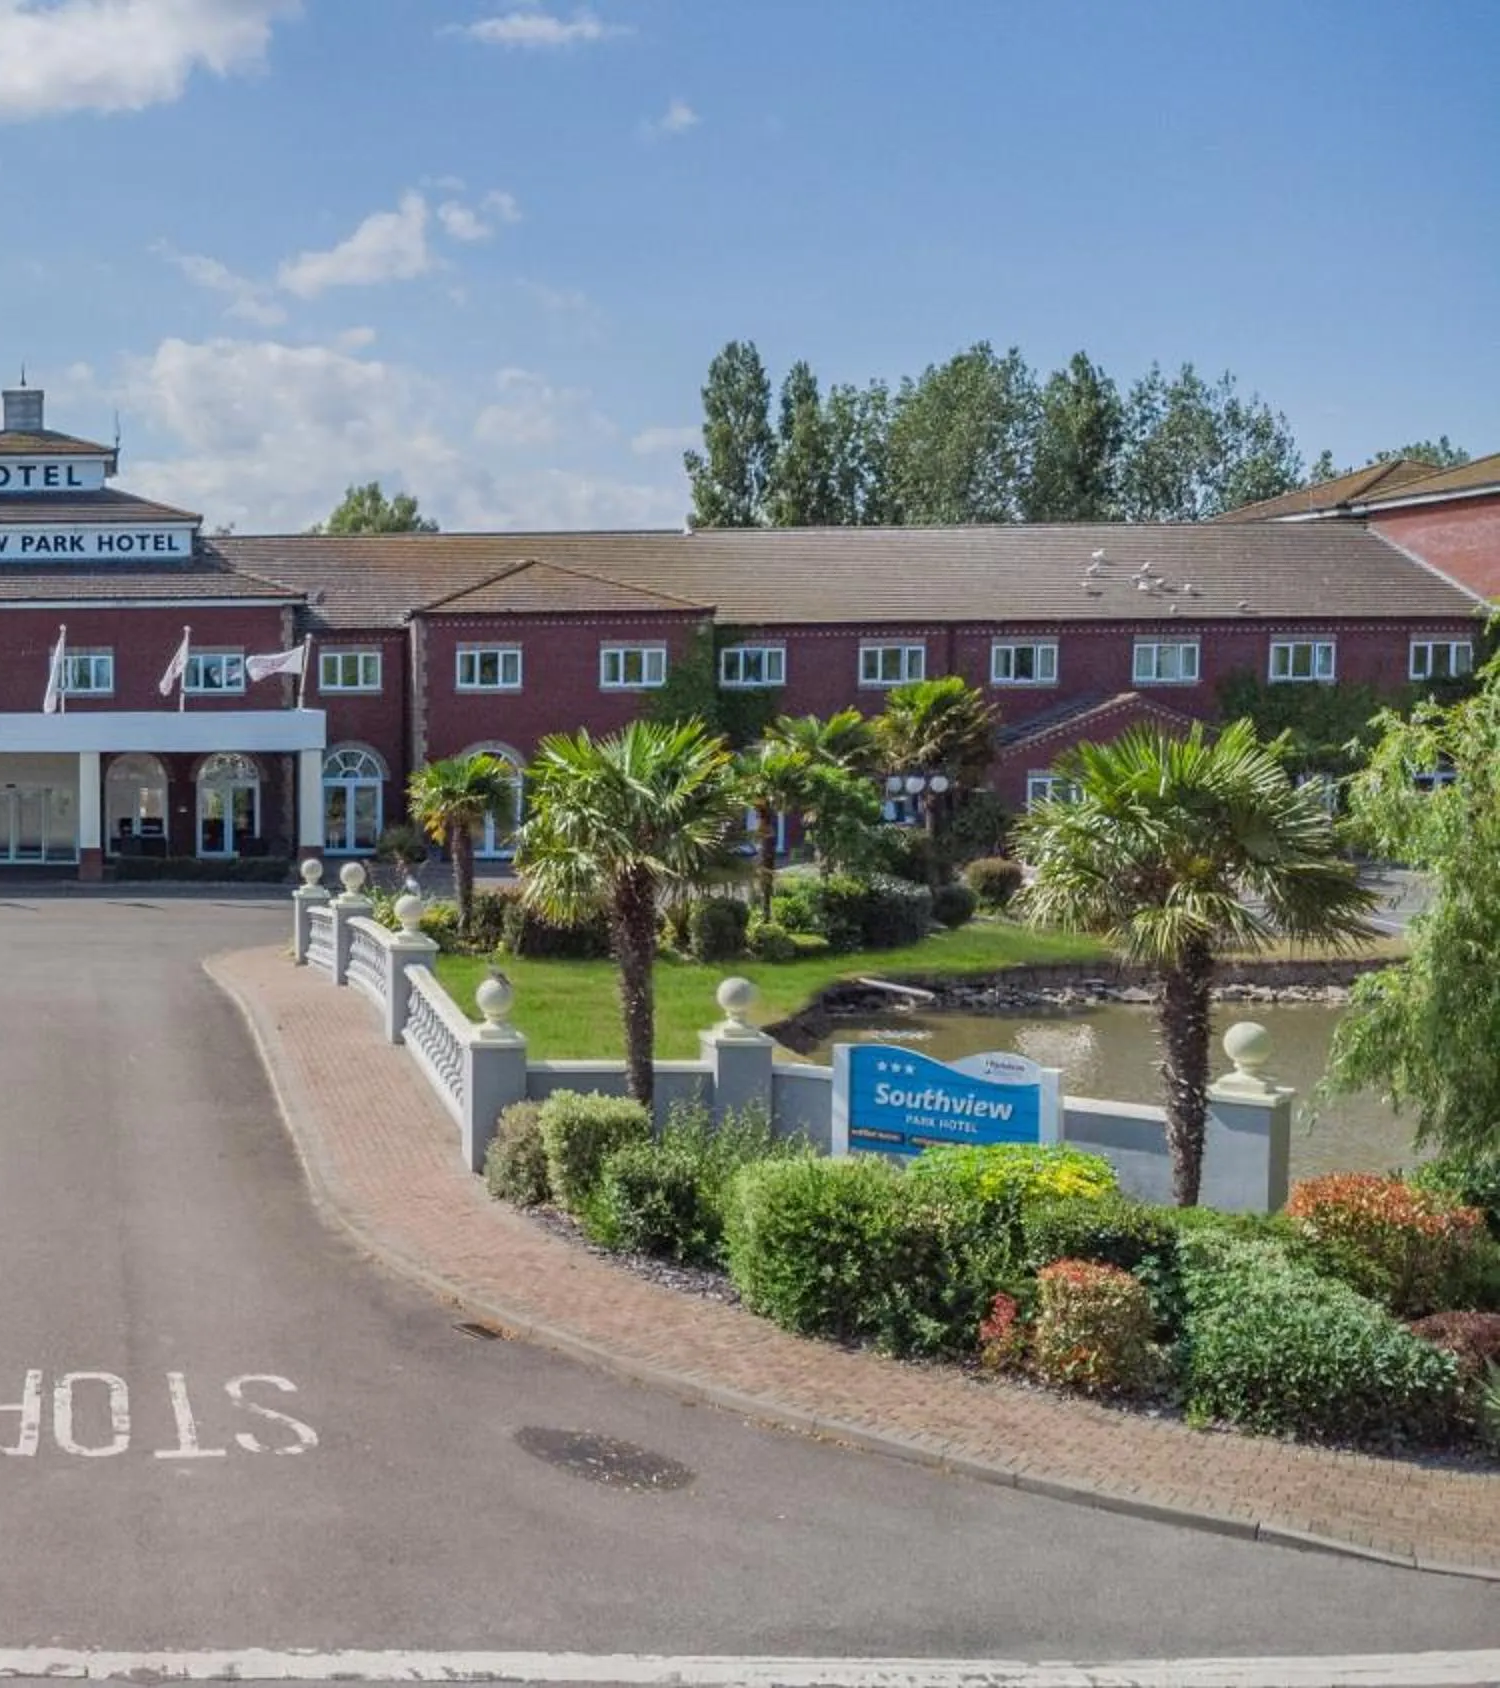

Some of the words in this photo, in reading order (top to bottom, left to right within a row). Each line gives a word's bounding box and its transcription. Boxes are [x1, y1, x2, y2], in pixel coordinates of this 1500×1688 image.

[21, 535, 85, 553] PARK
[97, 534, 180, 552] HOTEL
[874, 1082, 1013, 1121] Southview
[905, 1114, 936, 1127] PARK
[939, 1119, 979, 1134] HOTEL
